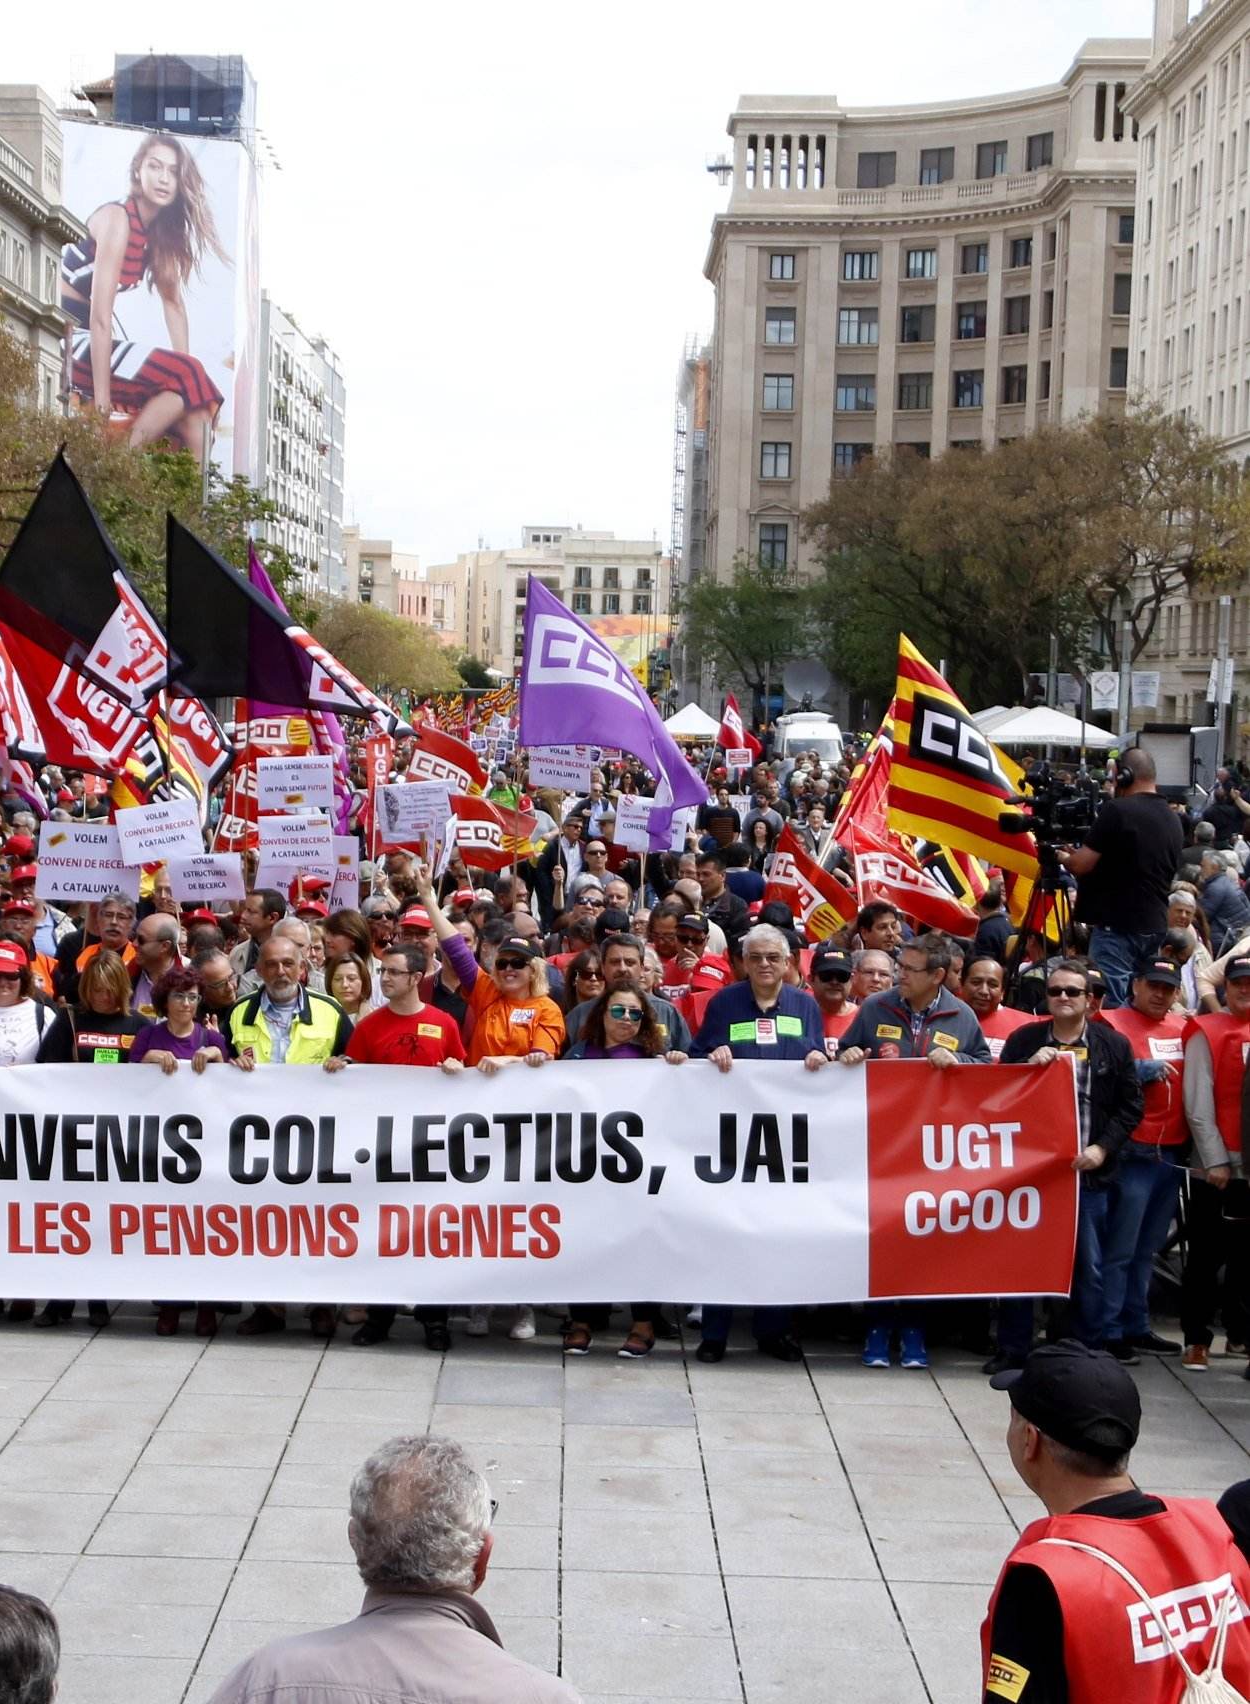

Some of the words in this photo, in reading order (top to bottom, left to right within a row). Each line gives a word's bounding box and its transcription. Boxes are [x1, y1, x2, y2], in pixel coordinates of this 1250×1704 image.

[76, 674, 131, 733] UGT
[416, 757, 469, 792] CCOO
[144, 811, 169, 821] VOLEM
[165, 819, 195, 830] RECERCA
[75, 834, 108, 845] VOLEM
[144, 833, 186, 848] CATALUNYA
[260, 838, 289, 846] CONVENI
[300, 837, 331, 845] RECERCA
[457, 825, 503, 848] COO
[278, 850, 320, 858] CATALUNYA
[38, 856, 82, 868] CONVENI
[84, 859, 97, 869] DE
[51, 882, 59, 892] A
[63, 883, 121, 894] CATALUNYA
[78, 1034, 118, 1046] CCOO
[229, 1111, 667, 1195] COL·LECTIUS,
[693, 1111, 810, 1184] JA!
[921, 1121, 1022, 1171] UGT
[903, 1185, 1042, 1237] CCOO
[7, 1201, 91, 1255] LES
[110, 1202, 360, 1258] PENSIONS
[377, 1202, 561, 1259] DIGNES
